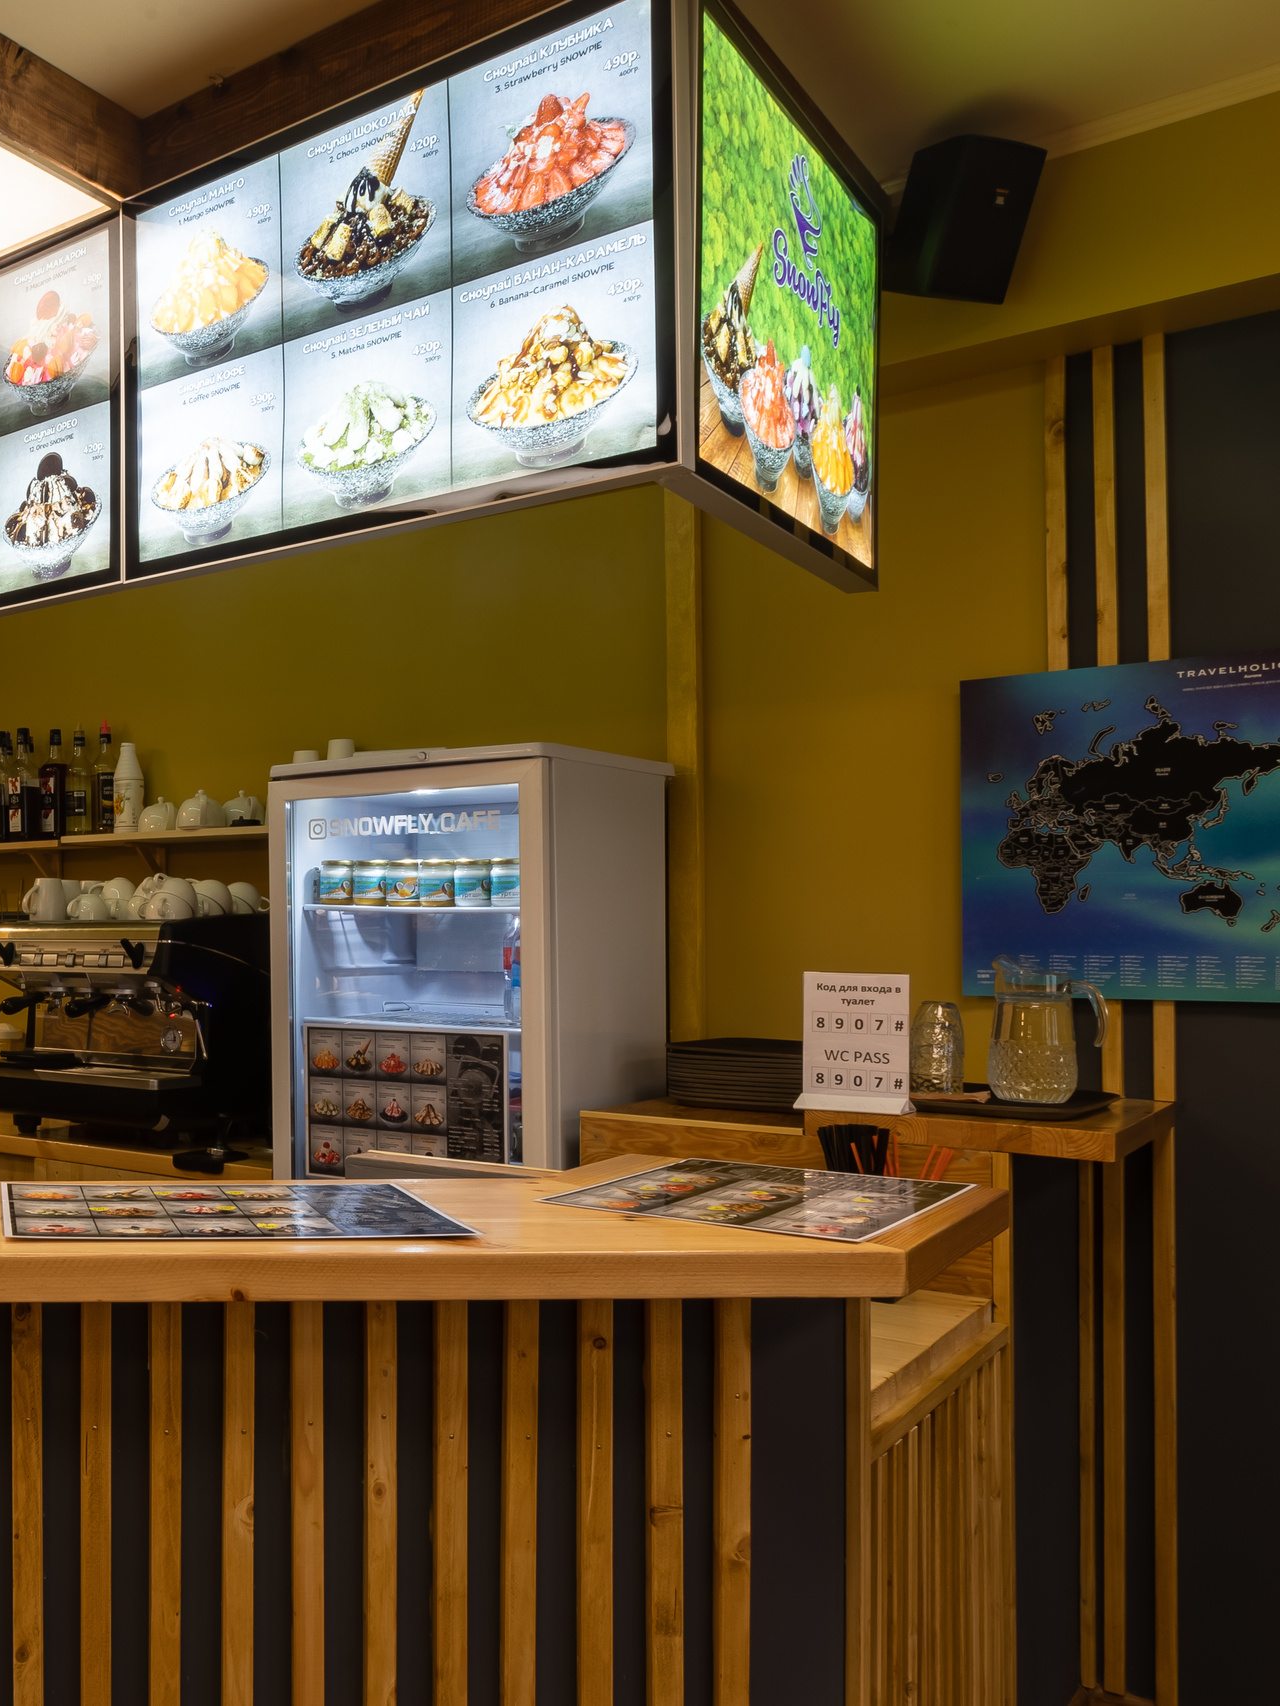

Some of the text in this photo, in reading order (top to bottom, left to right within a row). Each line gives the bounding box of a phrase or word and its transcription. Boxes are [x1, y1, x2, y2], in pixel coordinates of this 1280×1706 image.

[483, 17, 614, 82] Сноупай КЛУБНИКА
[603, 49, 640, 72] 490р.
[495, 40, 603, 93] 3. Strawberry SNOWPIE
[306, 103, 417, 158] Сноупай ШОКОЛАД
[336, 146, 359, 161] Choco
[360, 130, 397, 151] SNOWPIE
[409, 133, 440, 153] 420р.
[168, 177, 244, 217] Сноупай МАНГО
[184, 210, 203, 225] Mango
[204, 197, 235, 216] SNOWPIE
[246, 202, 272, 220] 490р.
[14, 247, 87, 286] Сноупай МАКАРОН
[30, 265, 77, 290] Macaron SNOWPIE
[460, 233, 647, 303] Сноупай БАНАН-КАРАМЕЛЬ
[498, 277, 569, 306] Banana-Caramel
[572, 262, 615, 282] SNOWPIE
[607, 278, 644, 296] 420р.
[302, 302, 430, 355] Сноупай ЗЕЛЕНЫЙ ЧАЙ
[338, 343, 366, 357] Matcha
[367, 331, 402, 348] SNOWPIE
[412, 339, 444, 357] 420р.
[176, 364, 245, 395] Сноупай КОФЕ
[189, 390, 209, 404] Coffee
[210, 382, 241, 398] SNOWPIE
[250, 391, 276, 407] 390р.
[24, 418, 78, 442] Сноупай ОРЕО
[36, 442, 49, 451] Oreo
[50, 433, 74, 446] SNOWPIE
[84, 442, 104, 454] 420р.
[1177, 663, 1280, 678] TRAVELHOLI
[330, 810, 500, 837] SNOWFLY CAFE
[817, 983, 836, 992] Код
[839, 985, 858, 993] для
[861, 986, 892, 994] входа
[841, 998, 875, 1006] туалет
[824, 1050, 890, 1064] WC PASS
